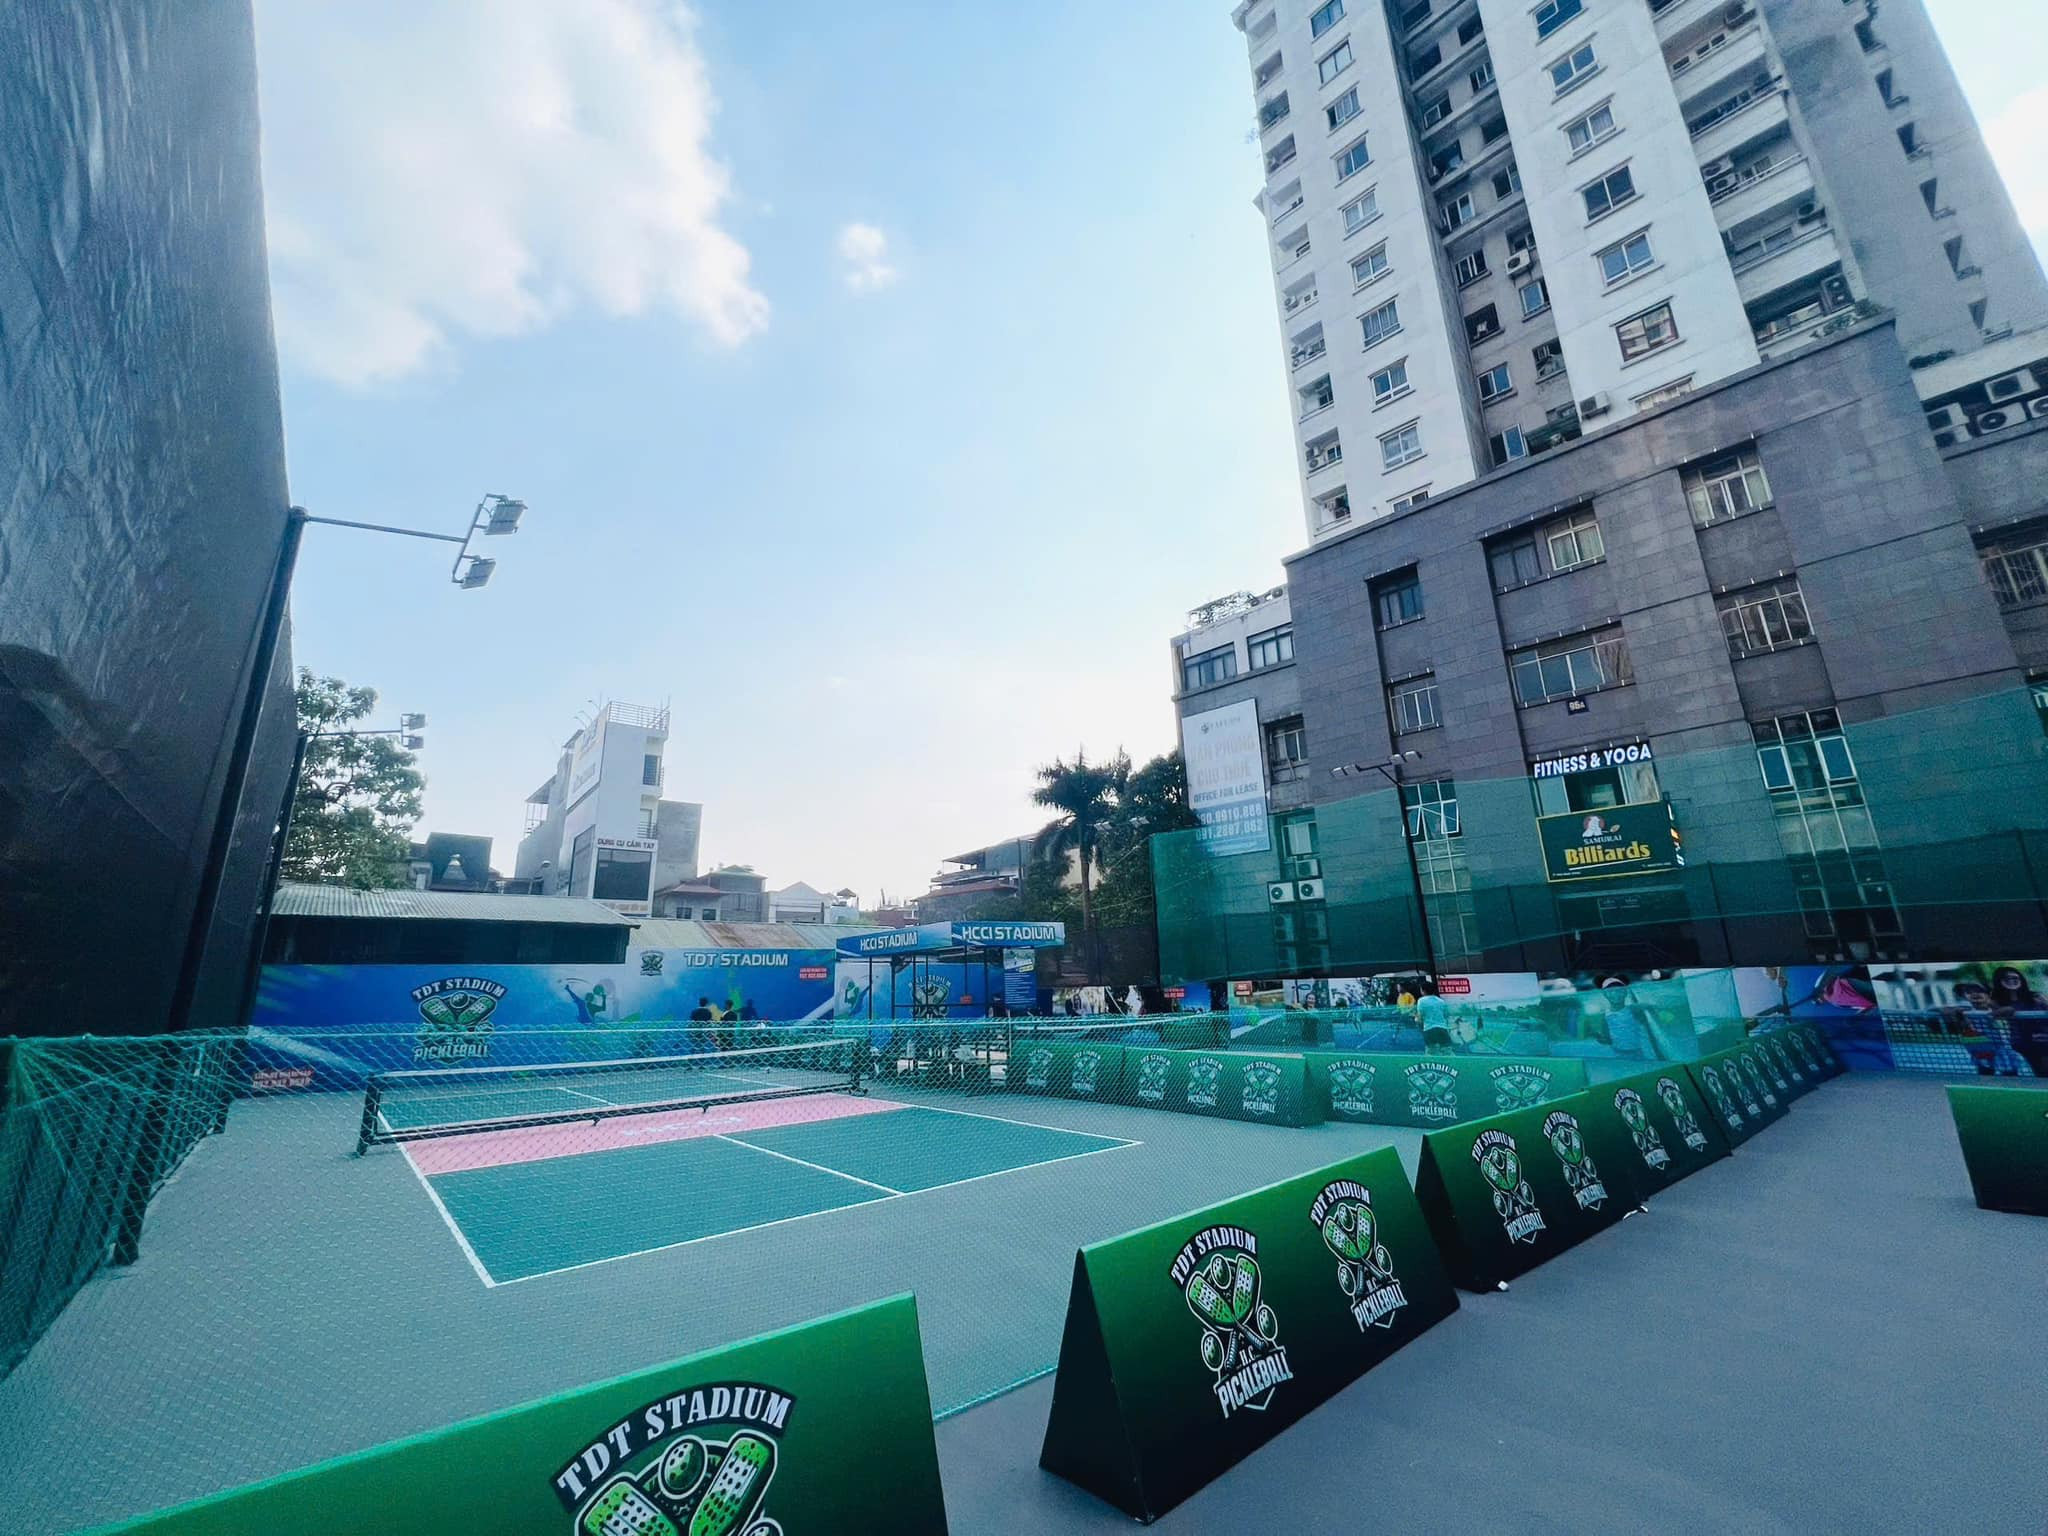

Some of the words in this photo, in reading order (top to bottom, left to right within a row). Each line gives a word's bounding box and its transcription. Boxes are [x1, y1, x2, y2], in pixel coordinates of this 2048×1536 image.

[1534, 755, 1587, 778] FITNESS
[1590, 752, 1601, 768] &
[1603, 744, 1651, 766] YOGA
[1235, 782, 1258, 794] LEASE
[1584, 835, 1622, 845] SAMURAI
[1564, 841, 1651, 866] Billiards
[860, 936, 877, 950] HCCI
[878, 931, 918, 949] STADIUM
[962, 926, 992, 940] HCCI
[993, 926, 1055, 941] STADIUM
[685, 953, 717, 966] TDT
[720, 953, 789, 967] STADIUM
[412, 982, 441, 999] TDT
[446, 978, 505, 997] STADIUM
[414, 1043, 489, 1062] PICKLEBALL
[1328, 1062, 1341, 1072] TDT
[1342, 1060, 1376, 1073] STADIUM
[1404, 1064, 1419, 1076] TDT
[1420, 1063, 1458, 1077] STADIUM
[1489, 1067, 1507, 1079] TDT
[1508, 1065, 1551, 1080] STADIUM
[1333, 1102, 1373, 1113] PICKLEBALL
[1411, 1105, 1458, 1119] PICKLEBALL
[1472, 1138, 1484, 1162] TDT
[1481, 1130, 1516, 1150] STADIUM
[1310, 1193, 1327, 1226] TDT
[1325, 1181, 1370, 1204] STADIUM
[1170, 1243, 1198, 1285] TDT
[1195, 1226, 1257, 1256] STADIUM
[1353, 1283, 1408, 1333] PICKLEBALL
[1217, 1351, 1294, 1419] PICKLEBALL
[557, 1420, 631, 1500] TDT
[644, 1387, 791, 1441] STADIUM
